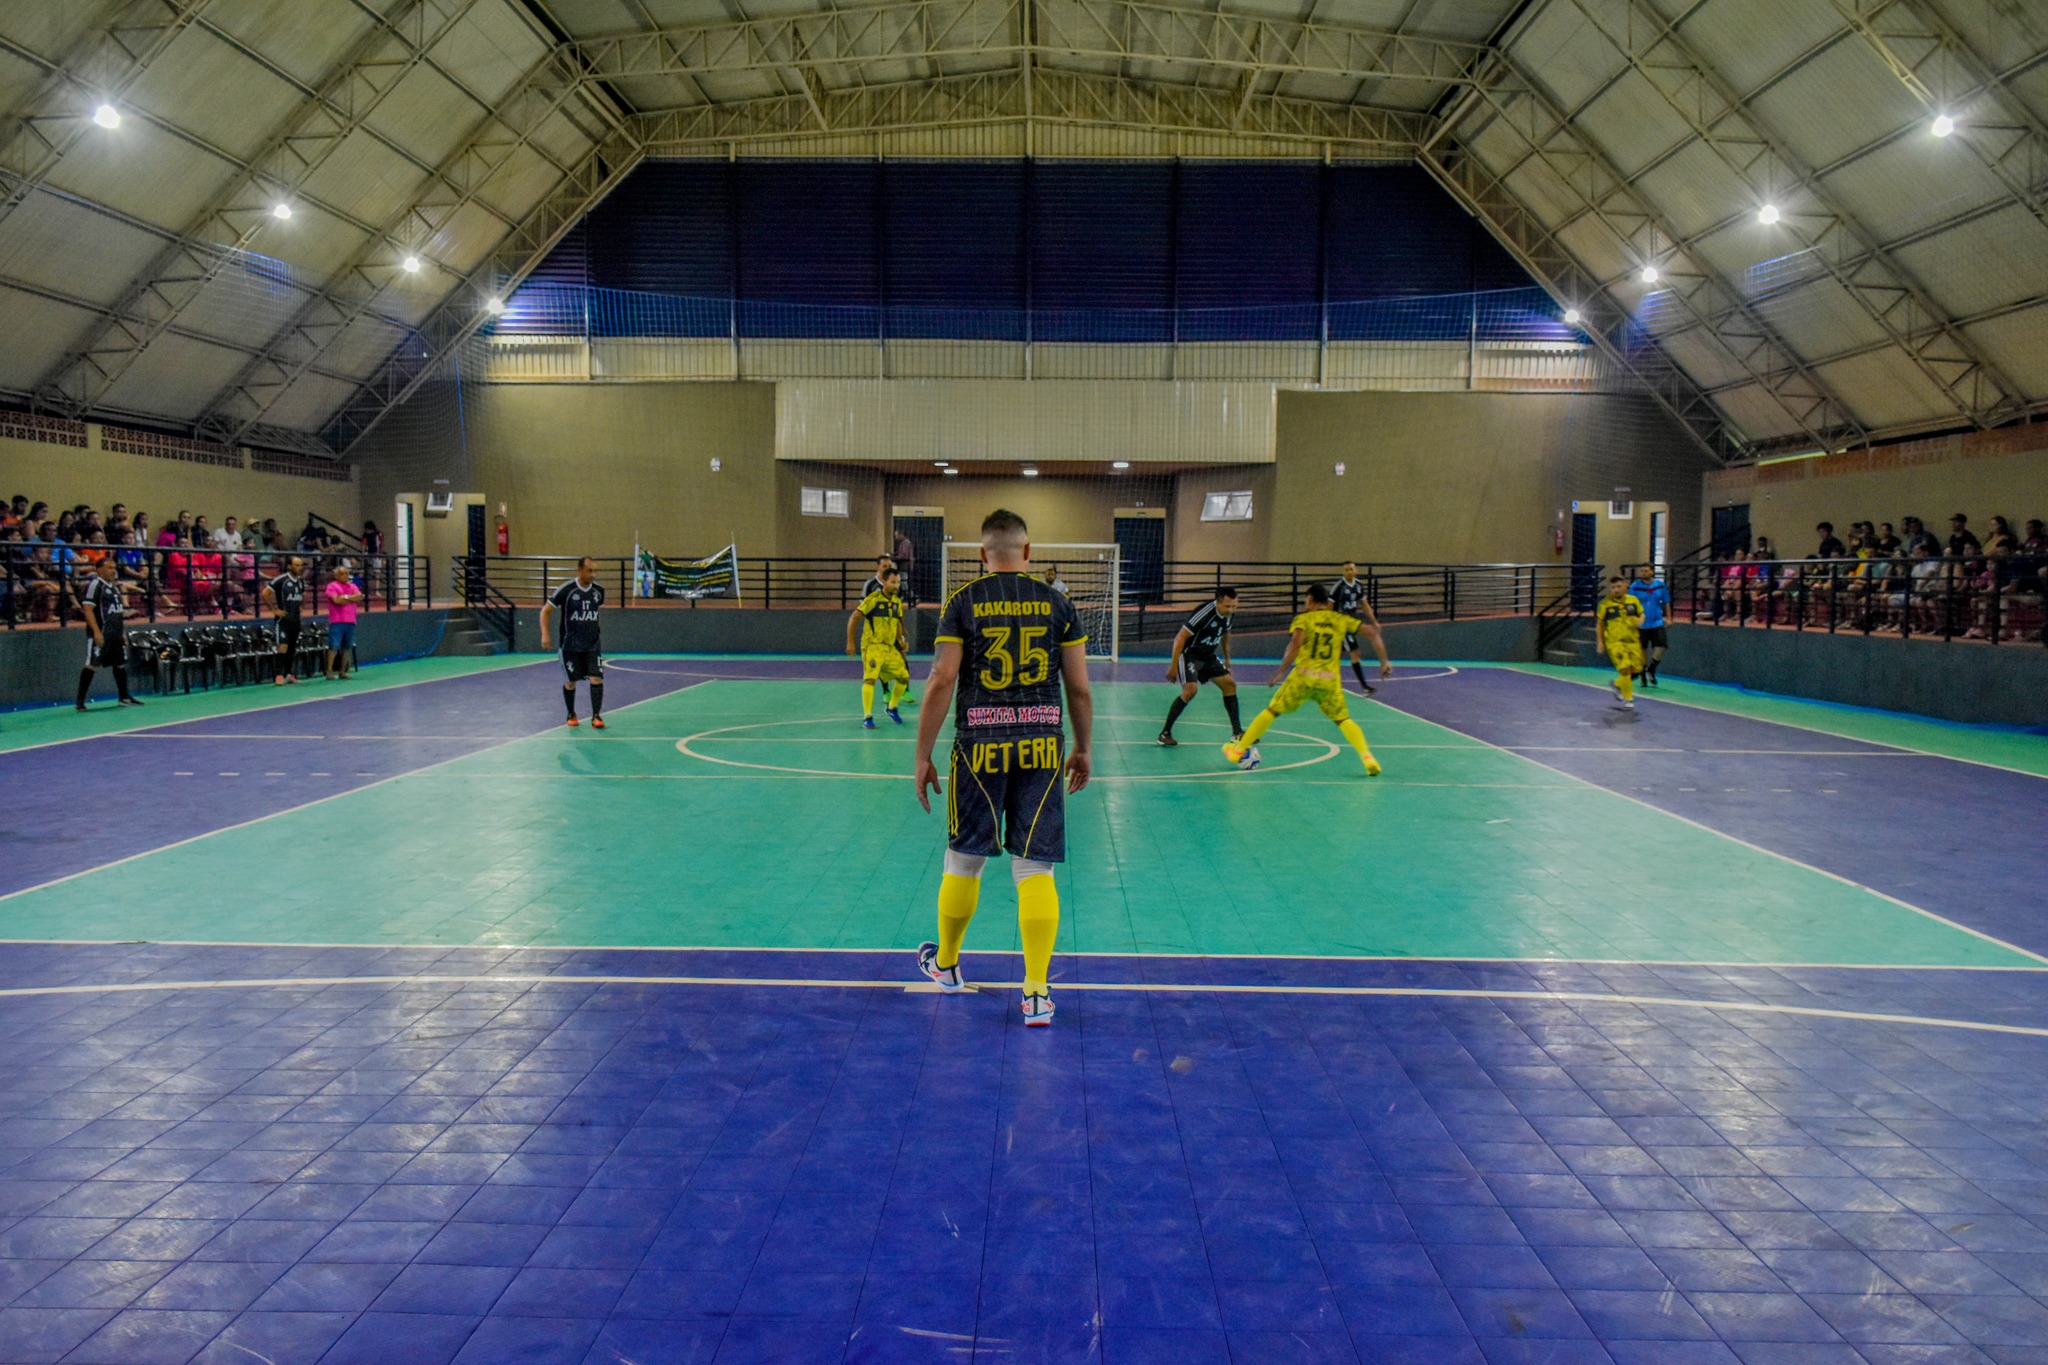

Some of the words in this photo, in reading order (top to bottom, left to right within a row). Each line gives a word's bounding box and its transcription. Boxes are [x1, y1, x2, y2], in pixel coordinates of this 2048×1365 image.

[570, 610, 599, 621] AJAX
[973, 601, 1052, 618] KAKAROTO
[1311, 632, 1334, 659] 13
[980, 626, 1050, 690] 35
[967, 708, 1016, 726] SUKITA
[1018, 705, 1060, 725] MOTOS
